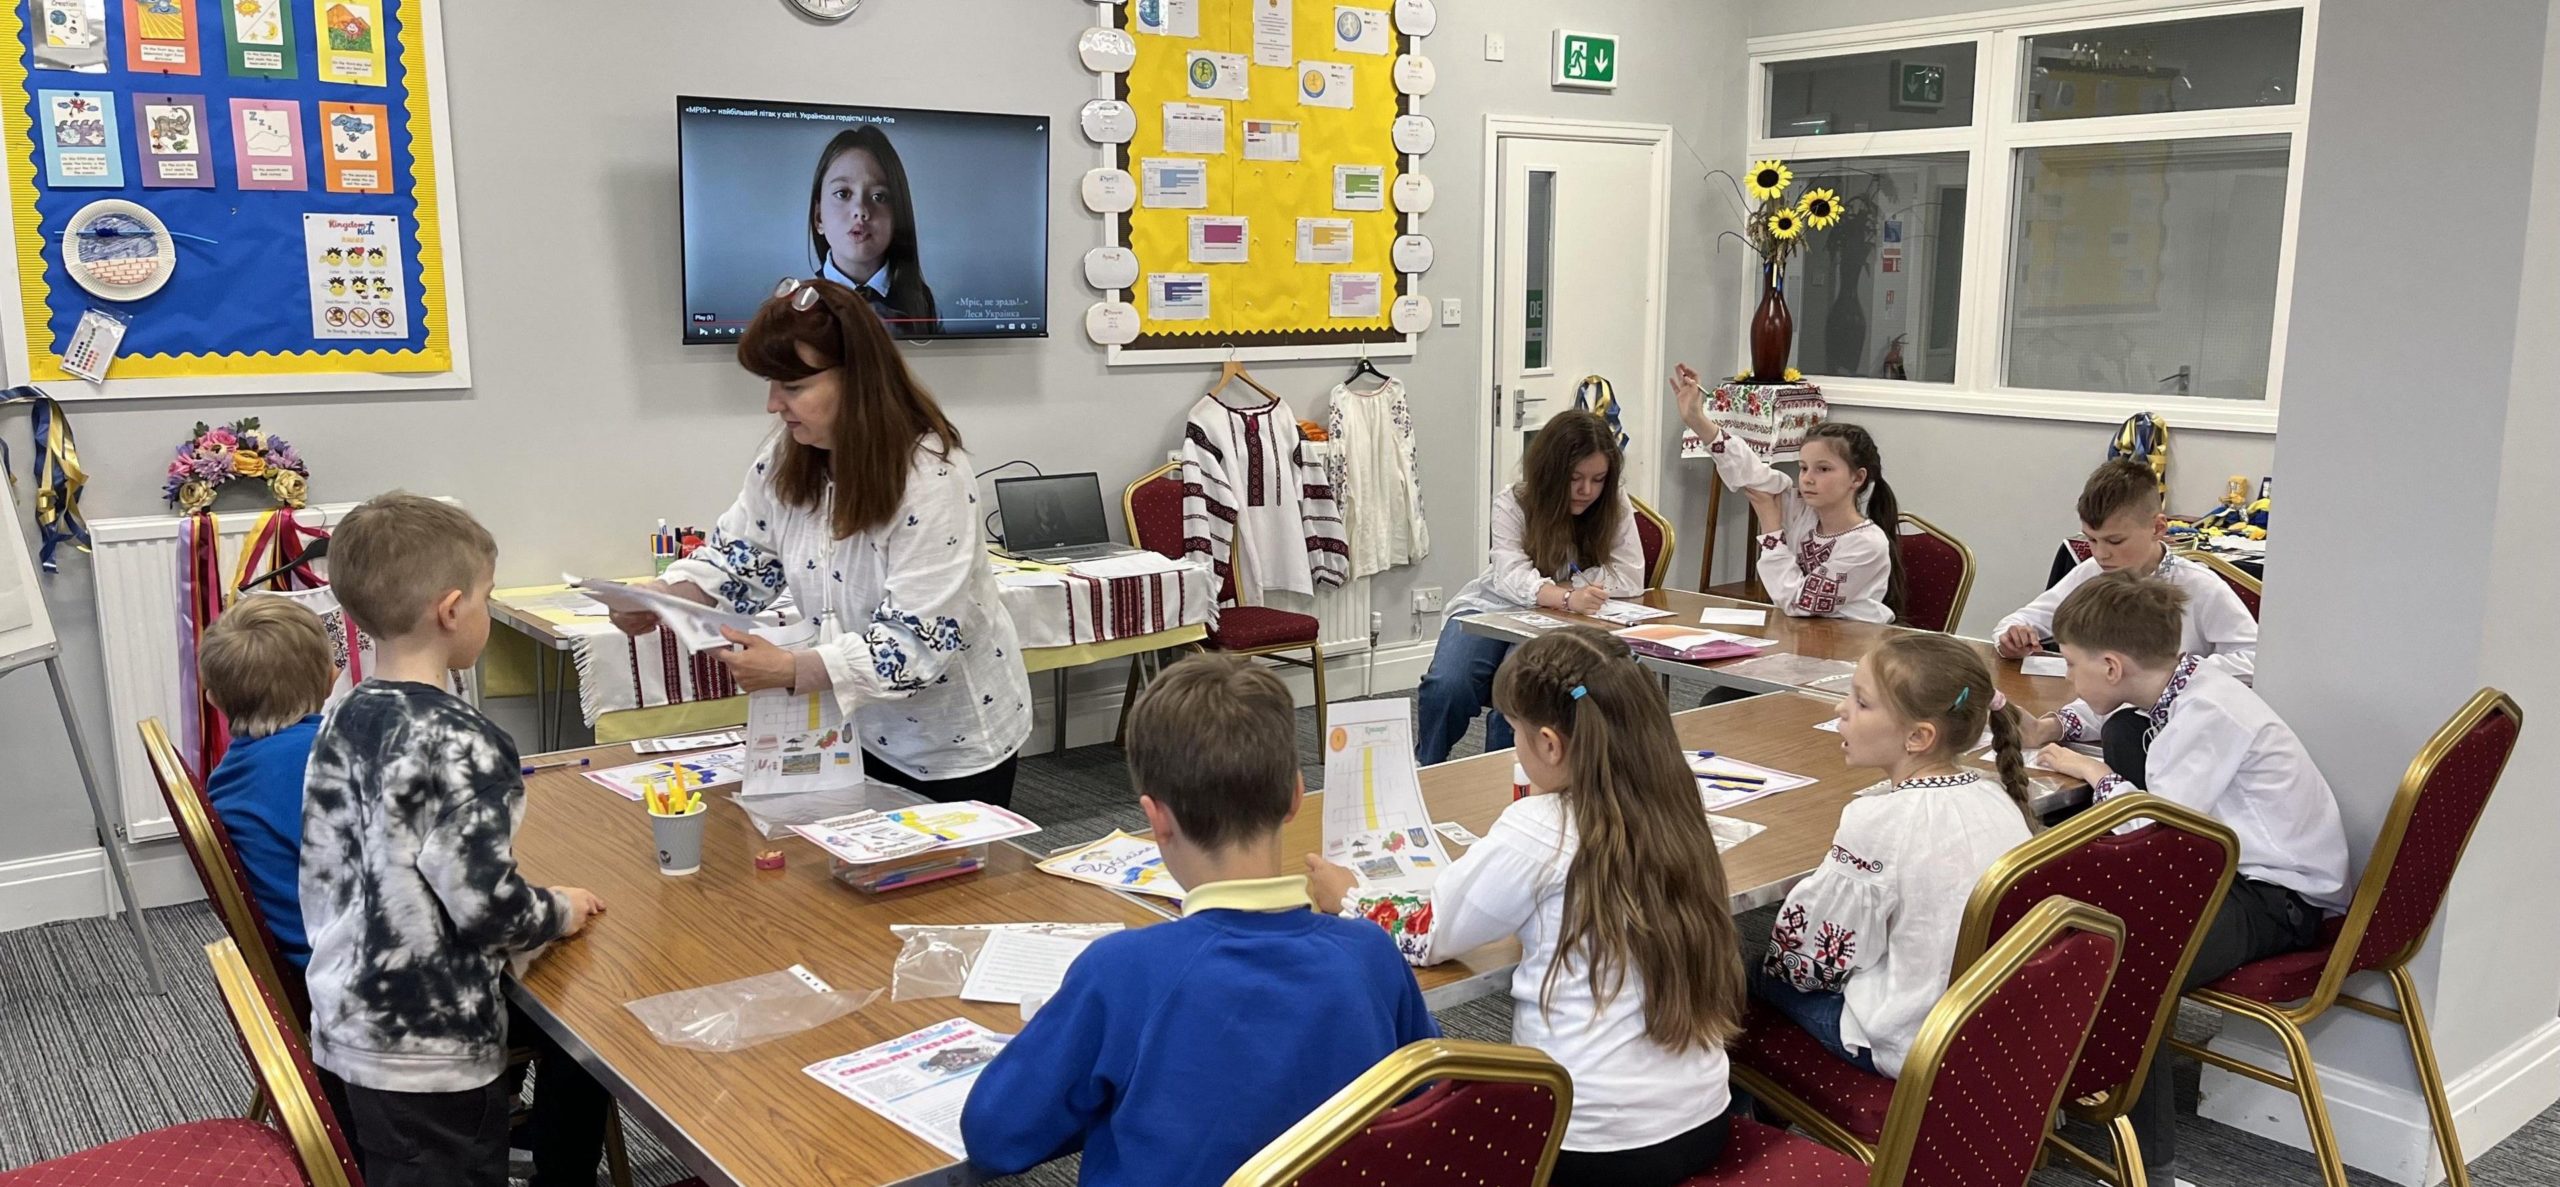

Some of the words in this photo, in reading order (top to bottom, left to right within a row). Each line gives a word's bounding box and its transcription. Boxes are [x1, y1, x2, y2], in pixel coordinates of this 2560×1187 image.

[718, 107, 758, 117] найбільший
[759, 109, 777, 117] літак
[800, 112, 835, 121] Українська
[868, 115, 883, 124] Lady
[328, 218, 366, 231] Kingdom
[357, 223, 375, 235] Kids
[964, 308, 983, 318] Леся
[985, 308, 1020, 319] Українка
